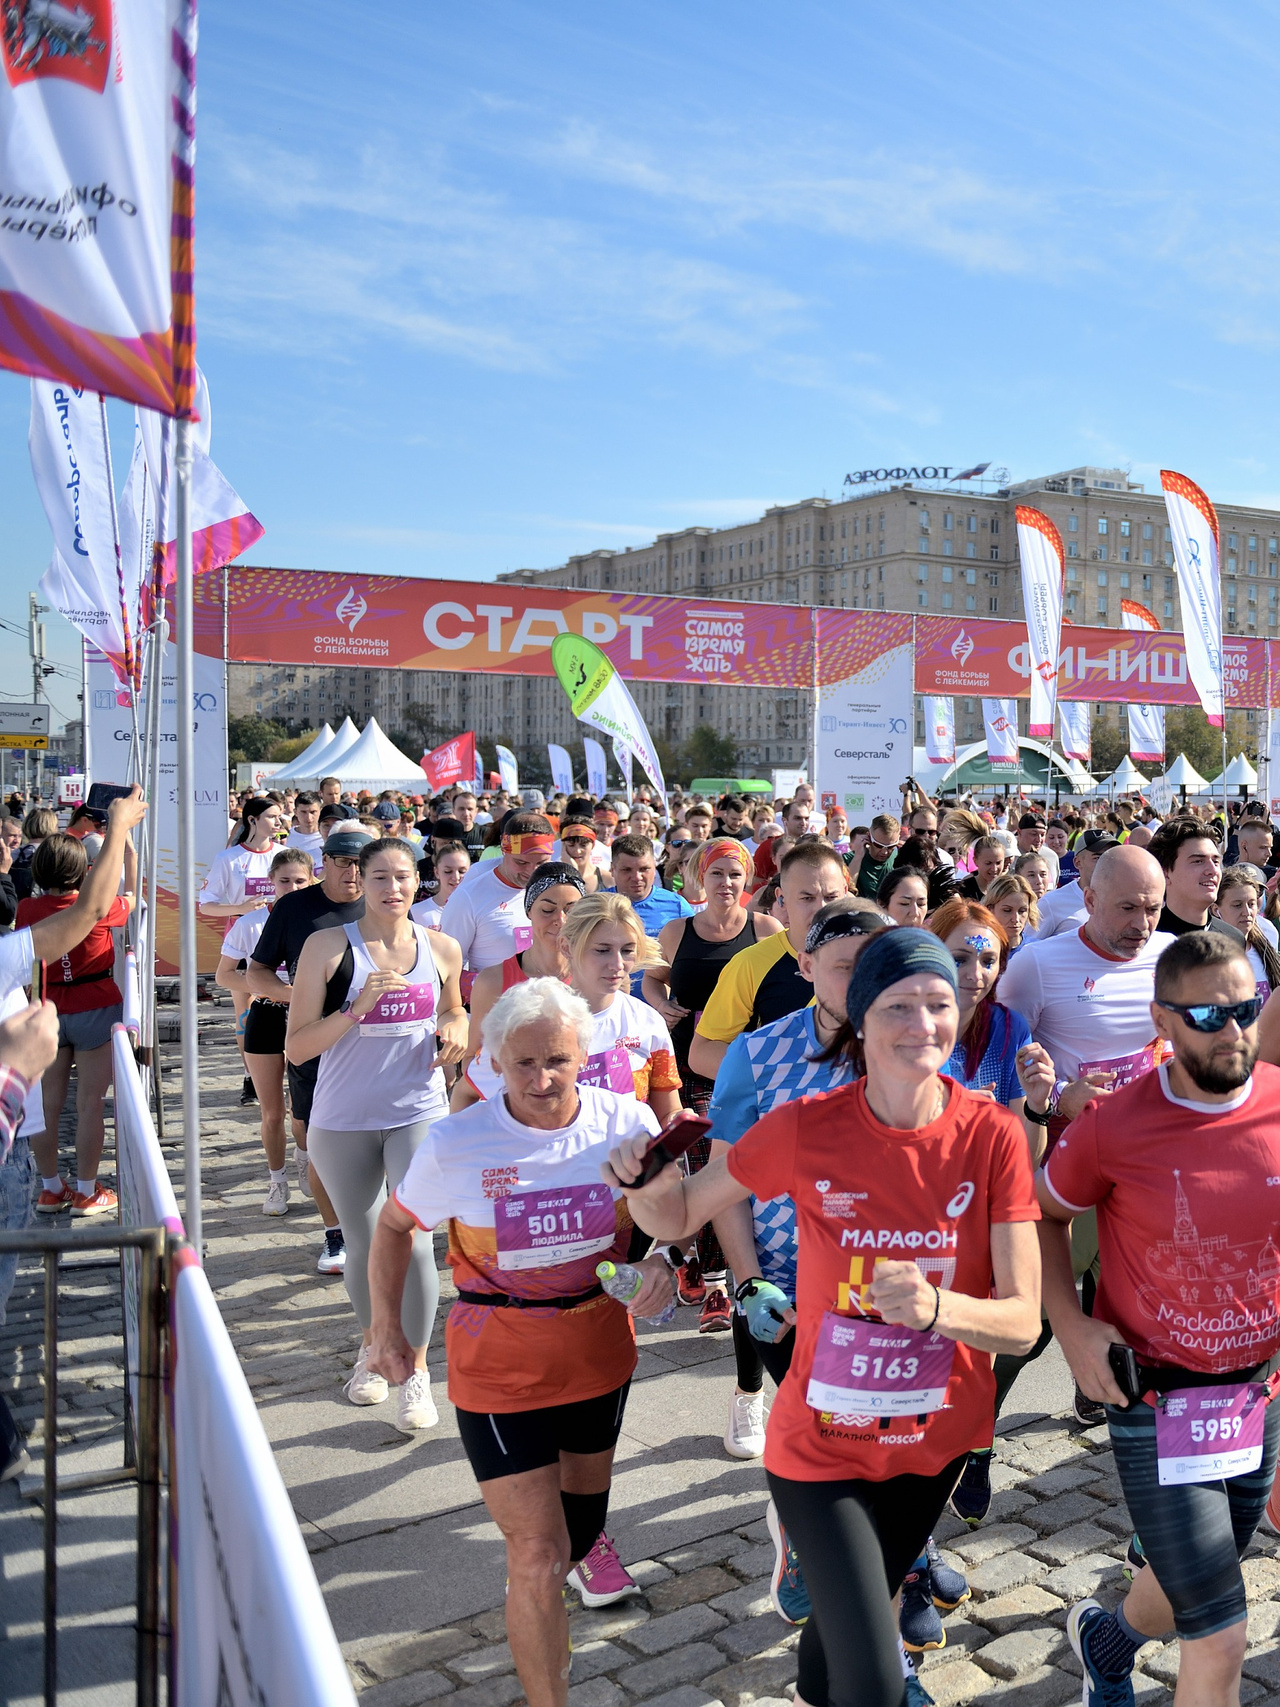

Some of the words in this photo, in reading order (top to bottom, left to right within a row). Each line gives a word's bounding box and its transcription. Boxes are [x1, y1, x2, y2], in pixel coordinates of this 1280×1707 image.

[844, 466, 952, 486] АЭРОФЛОТ
[422, 601, 654, 661] СТАРТ
[314, 636, 346, 646] ФОНД
[348, 637, 389, 647] БОРЬБЫ
[314, 645, 322, 653] С
[324, 645, 389, 656] ЛЕЙКЕМИЕЙ
[1007, 641, 1187, 684] ФИНИШ
[935, 670, 958, 678] ФОНД
[960, 671, 989, 679] БОРЬБЫ
[943, 678, 989, 687] ЛЕЙКЕМИЕЙ
[838, 720, 886, 728] Гарант-Инвест
[834, 748, 890, 760] Северсталь
[381, 1002, 415, 1016] 5971
[528, 1210, 584, 1235] 5011
[531, 1232, 584, 1247] ЛЮДМИЛА
[840, 1229, 958, 1249] МАРАФОН
[851, 1354, 919, 1379] 5163
[820, 1428, 878, 1442] MARATHON
[879, 1431, 925, 1444] MOSCOW
[1190, 1416, 1243, 1442] 5959
